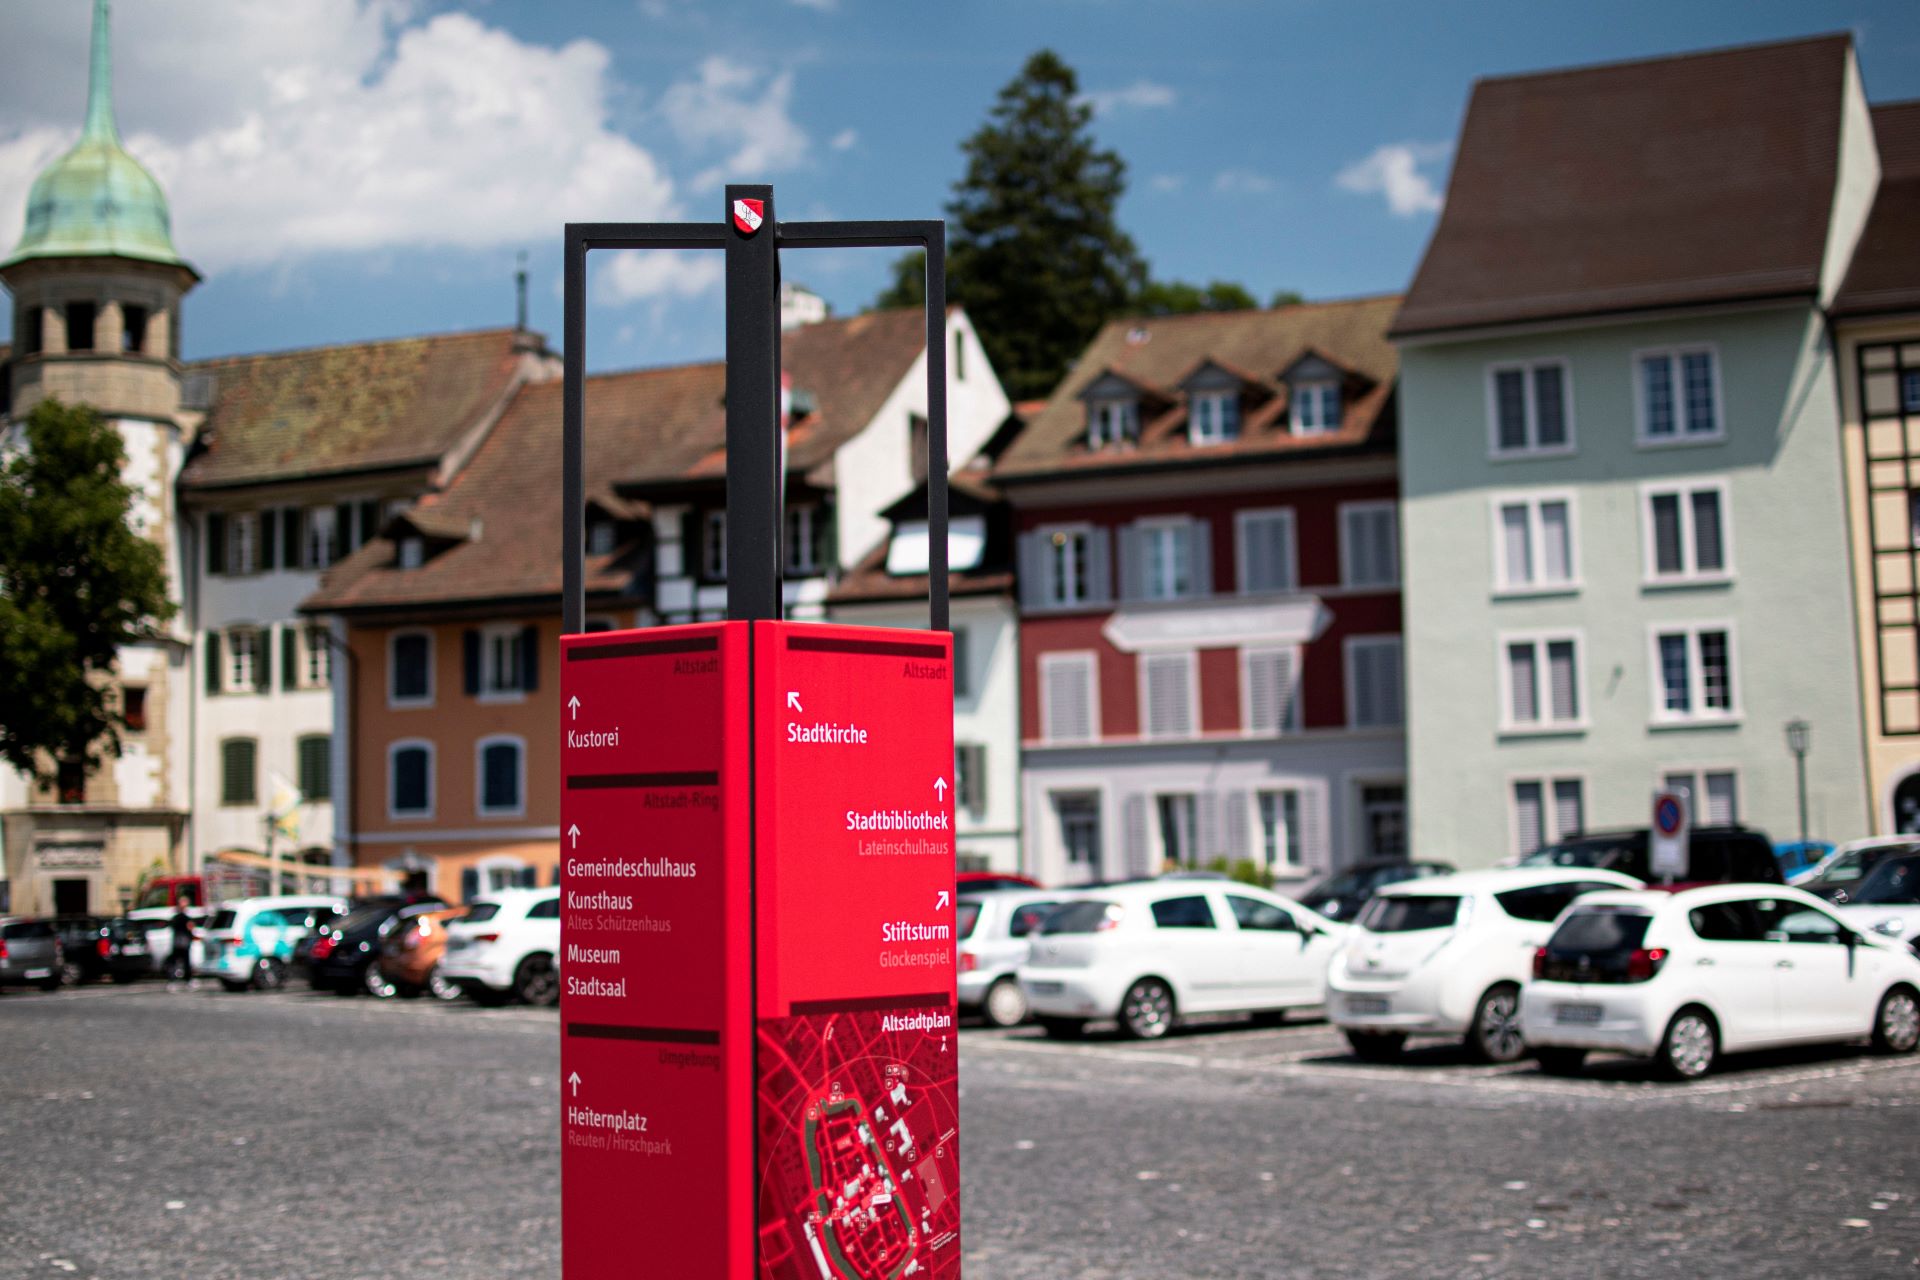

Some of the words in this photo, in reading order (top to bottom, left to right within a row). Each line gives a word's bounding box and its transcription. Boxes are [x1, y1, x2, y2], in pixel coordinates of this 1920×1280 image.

[673, 658, 718, 675] Altstadt
[902, 661, 947, 681] Altstadt
[567, 726, 619, 749] Kustorei
[787, 722, 868, 744] Stadtkirche
[846, 810, 949, 831] Stadtbibliothek
[858, 838, 949, 856] Lateinschulhaus
[567, 857, 697, 878] Gemeindeschulhaus
[567, 890, 633, 911] Kunsthaus
[567, 915, 594, 931] Altes
[597, 914, 672, 932] Schützenhaus
[882, 920, 950, 942] Stiftsturm
[567, 943, 620, 964] Museum
[879, 948, 950, 969] Glockenspiel
[567, 975, 627, 998] Stadtsaal
[881, 1011, 951, 1033] Altstadtplan
[659, 1048, 720, 1072] Umgebung
[568, 1105, 648, 1134] Heiternplatz
